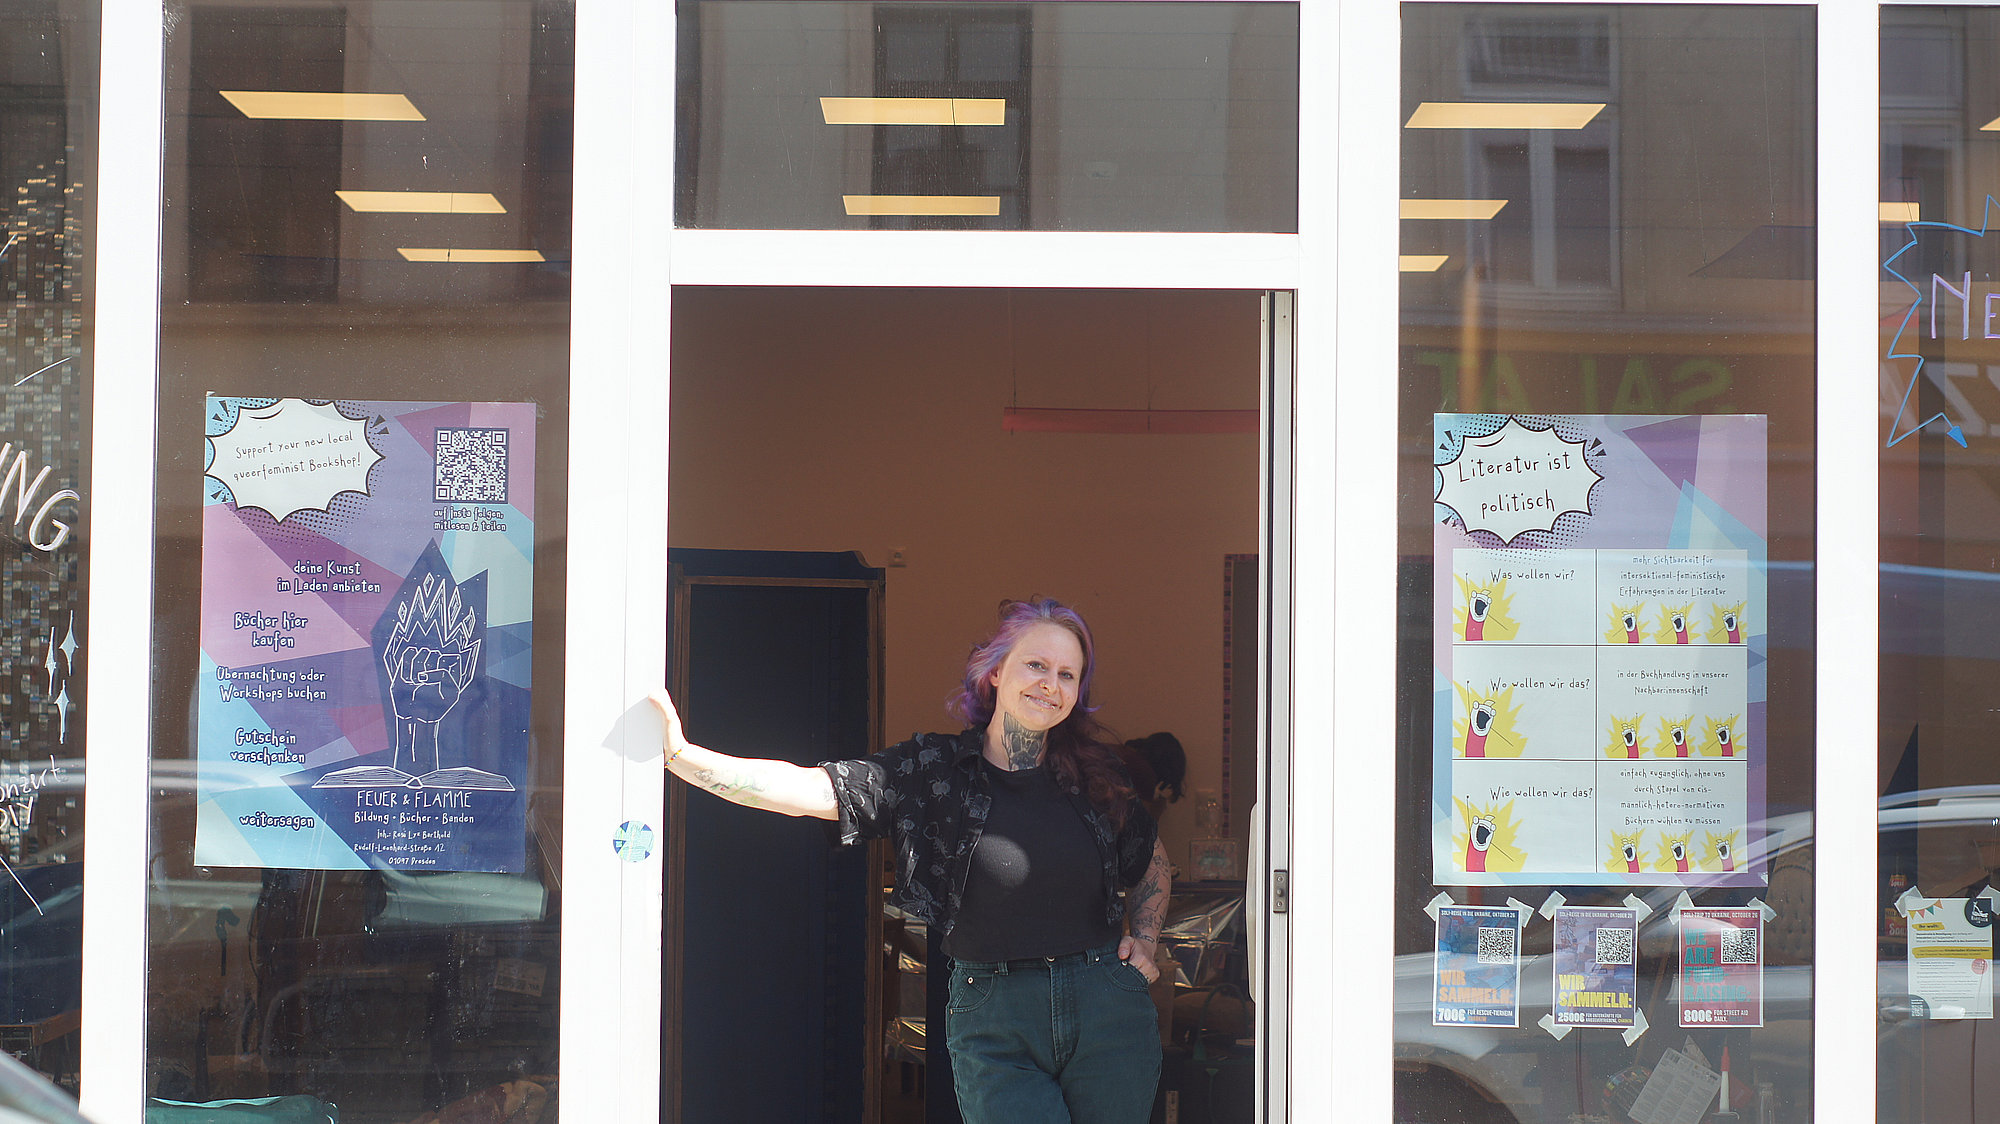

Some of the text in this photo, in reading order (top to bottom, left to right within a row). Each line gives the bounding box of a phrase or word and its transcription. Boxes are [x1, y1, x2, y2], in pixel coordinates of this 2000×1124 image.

[235, 430, 353, 459] Support your new local
[233, 452, 361, 482] queerfeminist Bookshop!
[1458, 451, 1571, 482] Literatur ist
[1481, 489, 1555, 519] politisch
[433, 506, 448, 520] auf
[474, 506, 504, 521] folgen,
[433, 520, 506, 531] mitlesen & teilen
[1632, 554, 1714, 566] mehr Sichtbarkeit für
[293, 560, 361, 578] deine Kunst
[1490, 567, 1575, 583] Was wollen wir?
[277, 577, 381, 595] im Laden anbieten
[1619, 586, 1727, 597] Erfahrungen in der Literatur
[234, 611, 309, 631] Bücher hier
[251, 630, 295, 651] kaufen
[216, 666, 326, 684] Übernachtung oder
[1617, 669, 1624, 678] in
[1626, 669, 1638, 678] der
[1640, 669, 1690, 681] Buchhandlung
[1692, 669, 1699, 678] in
[219, 684, 327, 702] Workshops buchen
[1489, 677, 1590, 692] Wo wollen wir das?
[235, 727, 296, 747] Gutschein
[230, 746, 306, 766] verschenken
[1620, 767, 1647, 780] einfach
[1694, 768, 1711, 779] ohne
[1713, 770, 1726, 778] uns
[1489, 786, 1593, 801] Wie wollen wir das?
[1633, 784, 1655, 794] durch
[1656, 784, 1680, 795] Stapel
[1697, 785, 1712, 793] cis-
[357, 790, 473, 808] FEUER & FLAMME
[239, 811, 315, 831] weitersagen
[354, 811, 475, 825] Bildung Bücher Banden
[1625, 815, 1655, 826] Büchern
[1657, 815, 1682, 826] wühlen
[1695, 817, 1721, 825] müssen
[434, 843, 446, 853] 12
[1684, 928, 1707, 945] WE
[1684, 947, 1715, 964] ARE
[1440, 969, 1467, 985] WIR
[1559, 974, 1586, 990] WIR
[1439, 986, 1514, 1005] SAMMELN:
[1559, 991, 1633, 1009] SAMMELN:
[1683, 985, 1752, 1002] RAISING:
[1438, 1008, 1466, 1022] 700€
[1557, 1012, 1585, 1023] 2500€
[1684, 1009, 1713, 1023] 800€
